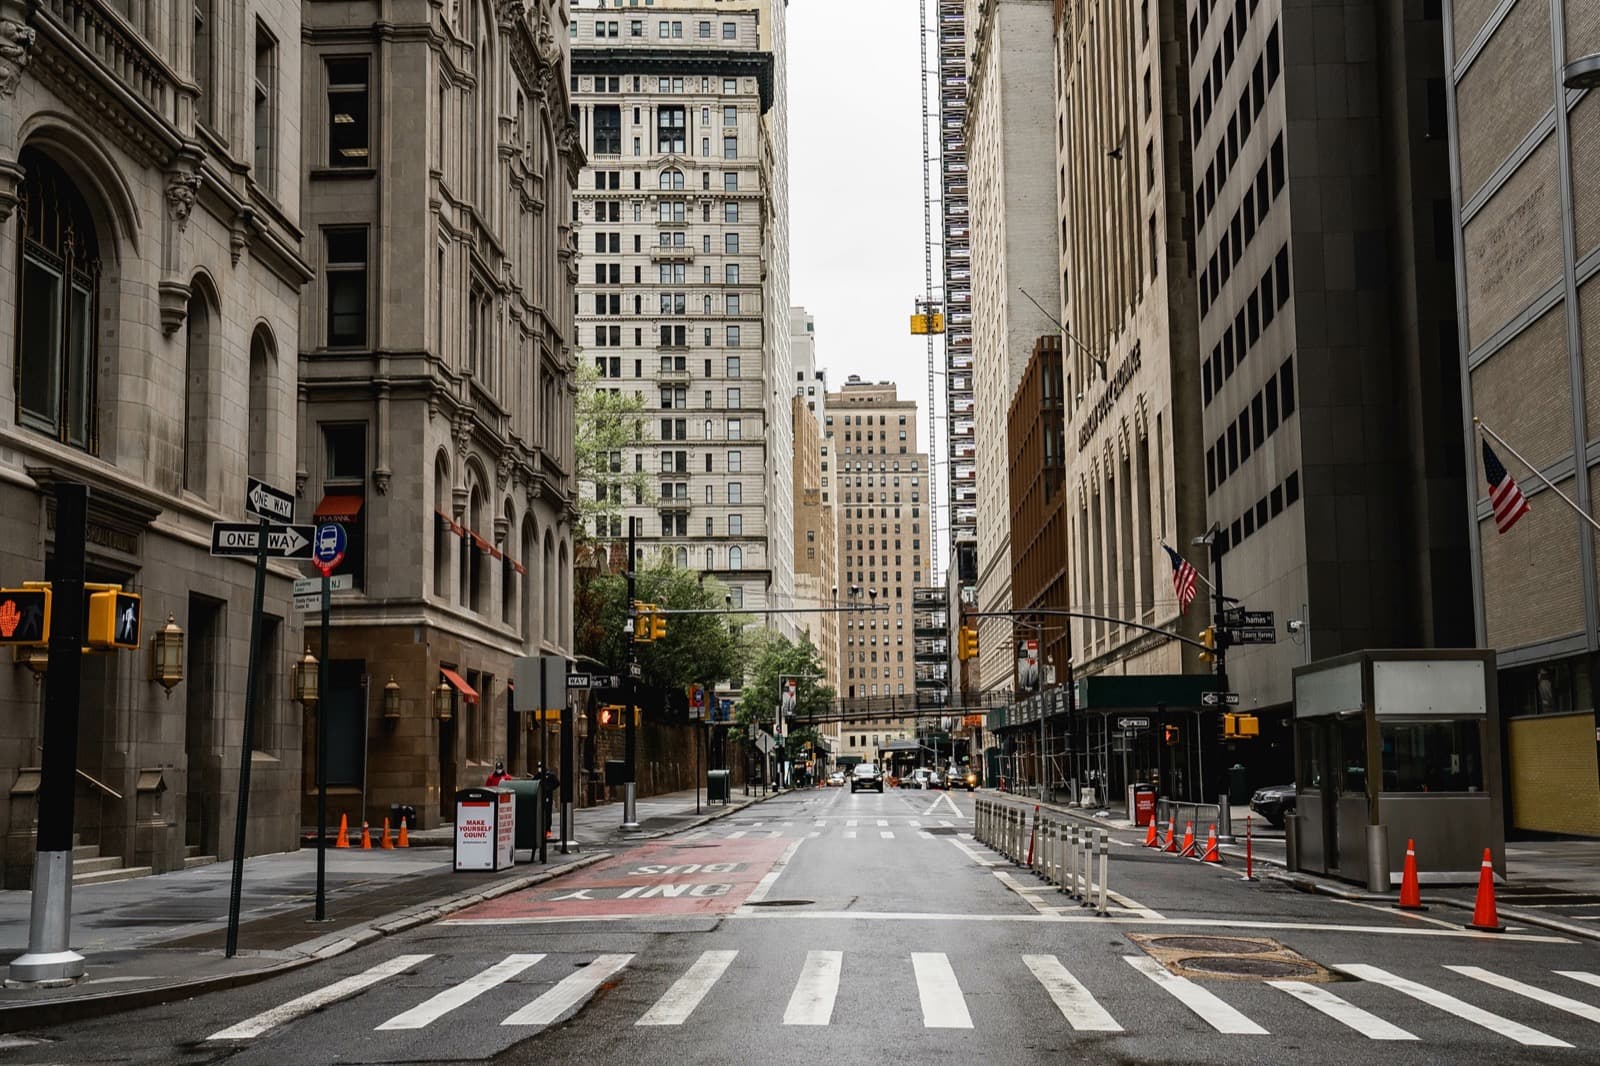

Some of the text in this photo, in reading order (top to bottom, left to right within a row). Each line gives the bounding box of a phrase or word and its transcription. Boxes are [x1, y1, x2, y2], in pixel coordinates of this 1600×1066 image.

[253, 490, 289, 511] ONE WAY
[226, 532, 256, 546] ONE
[269, 535, 300, 548] WAY
[331, 579, 341, 588] NJ
[1245, 615, 1266, 624] hames
[569, 677, 586, 686] WAY
[628, 863, 741, 875] BUS
[550, 883, 734, 901] ONLY
